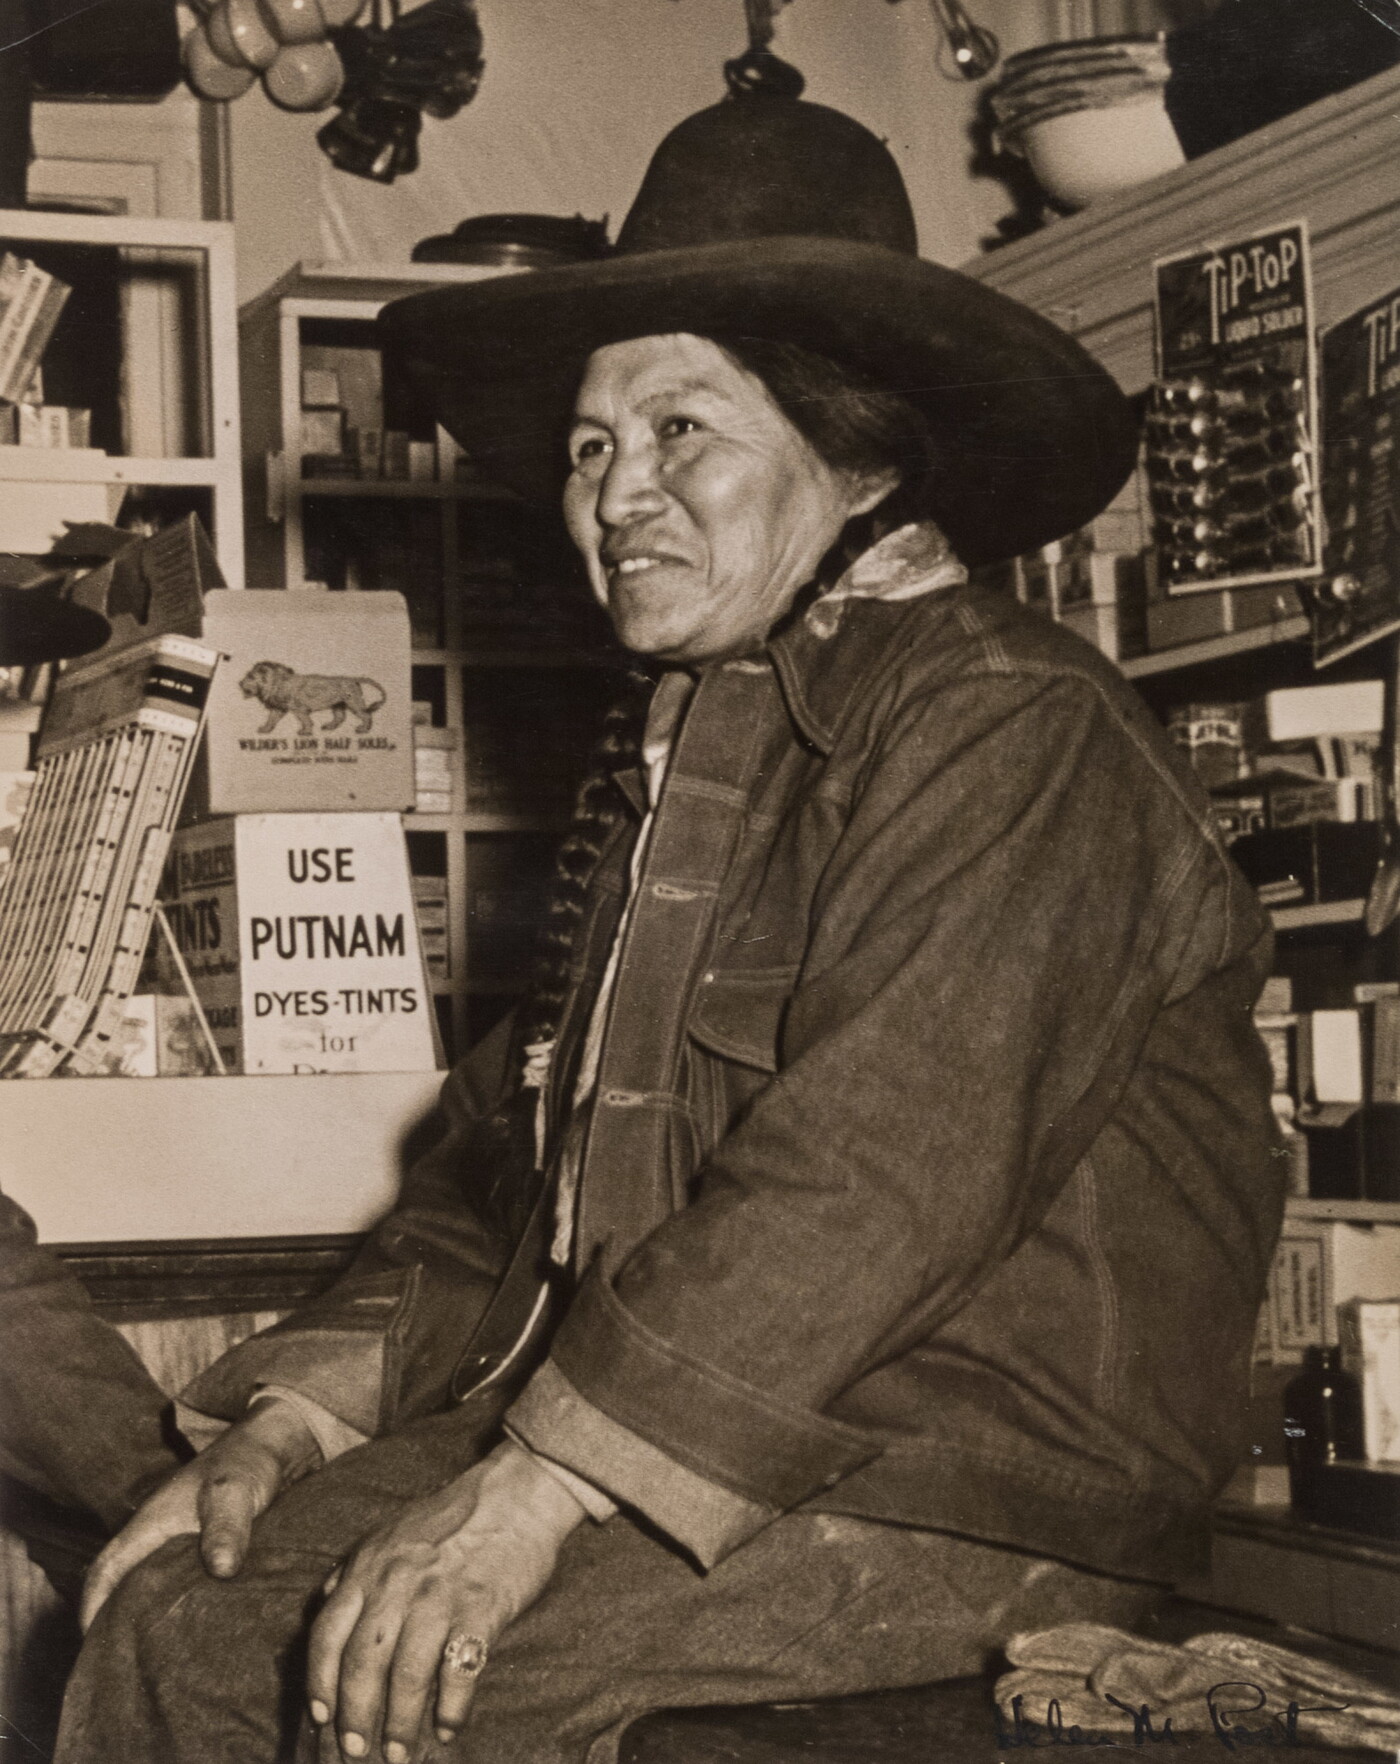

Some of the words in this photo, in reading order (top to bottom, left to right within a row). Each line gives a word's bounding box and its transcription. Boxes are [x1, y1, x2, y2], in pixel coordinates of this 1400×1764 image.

[294, 739, 318, 750] LION
[324, 738, 351, 750] HALF
[288, 848, 355, 883] USE
[251, 913, 405, 960] PUTNAM
[254, 988, 418, 1017] DYES-TINTS
